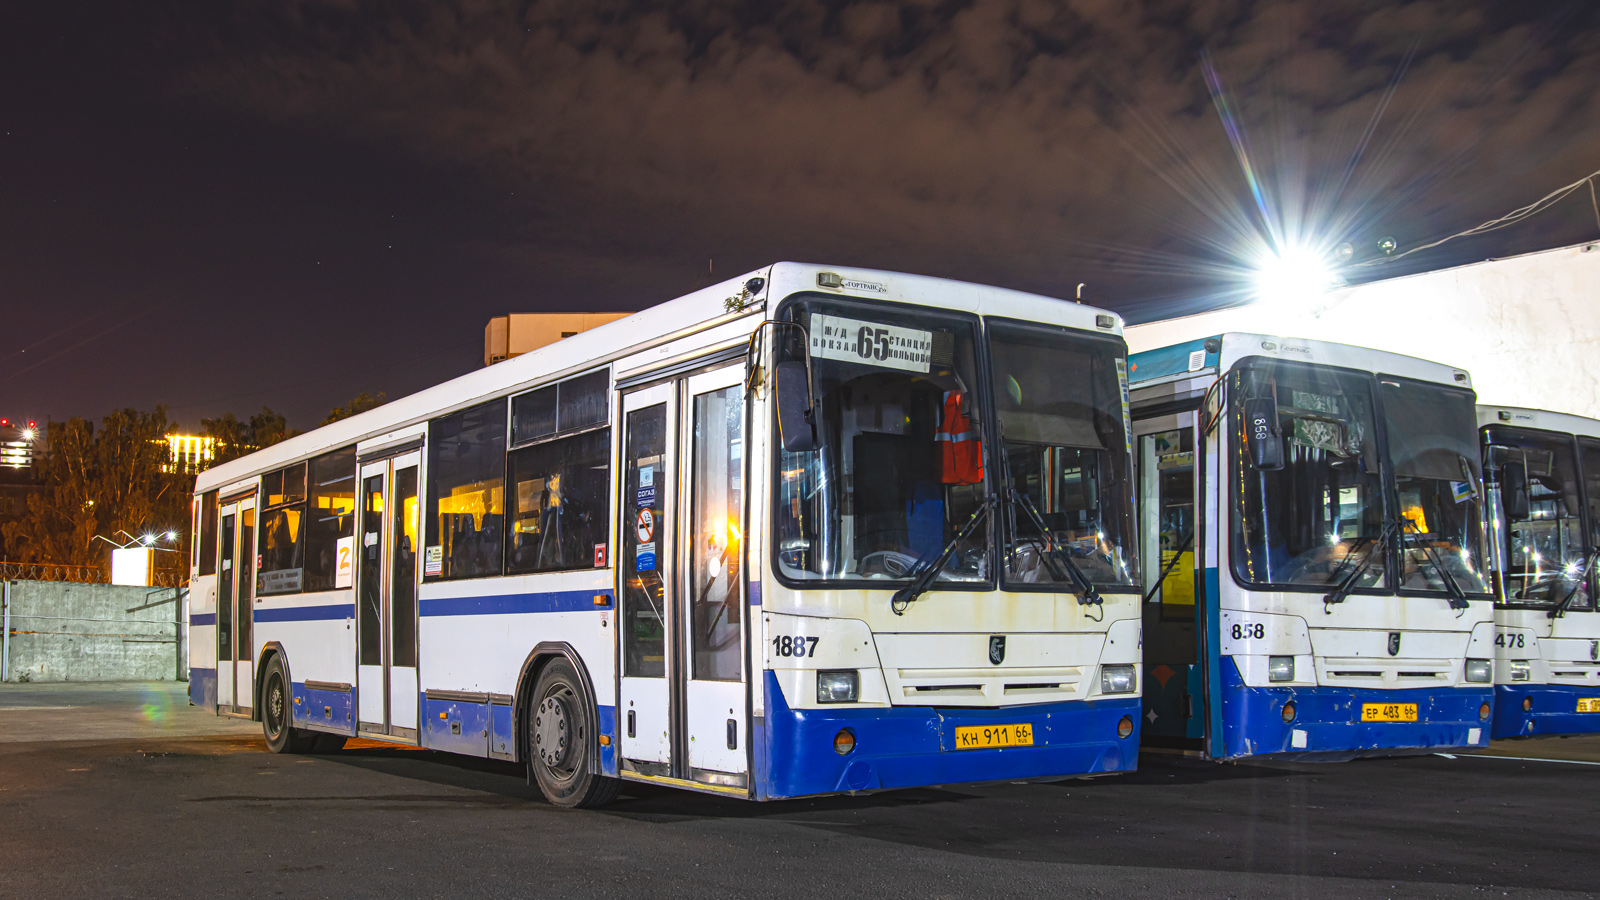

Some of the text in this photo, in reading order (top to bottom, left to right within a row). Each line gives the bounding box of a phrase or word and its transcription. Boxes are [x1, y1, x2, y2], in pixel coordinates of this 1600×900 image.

[813, 338, 857, 353] ВОКЗАЛ
[857, 326, 890, 361] 65
[889, 336, 931, 350] СТАНЦИЯ
[888, 348, 931, 363] КОЛЬЦОВО
[1253, 418, 1267, 440] 858
[638, 489, 655, 498] СОГАЗ
[339, 546, 350, 570] 2
[1231, 623, 1265, 640] 858
[772, 635, 820, 658] 1887
[1494, 633, 1525, 648] 478
[1382, 705, 1400, 719] 483
[1404, 705, 1414, 715] 66
[961, 725, 1028, 745] КН 911 66
